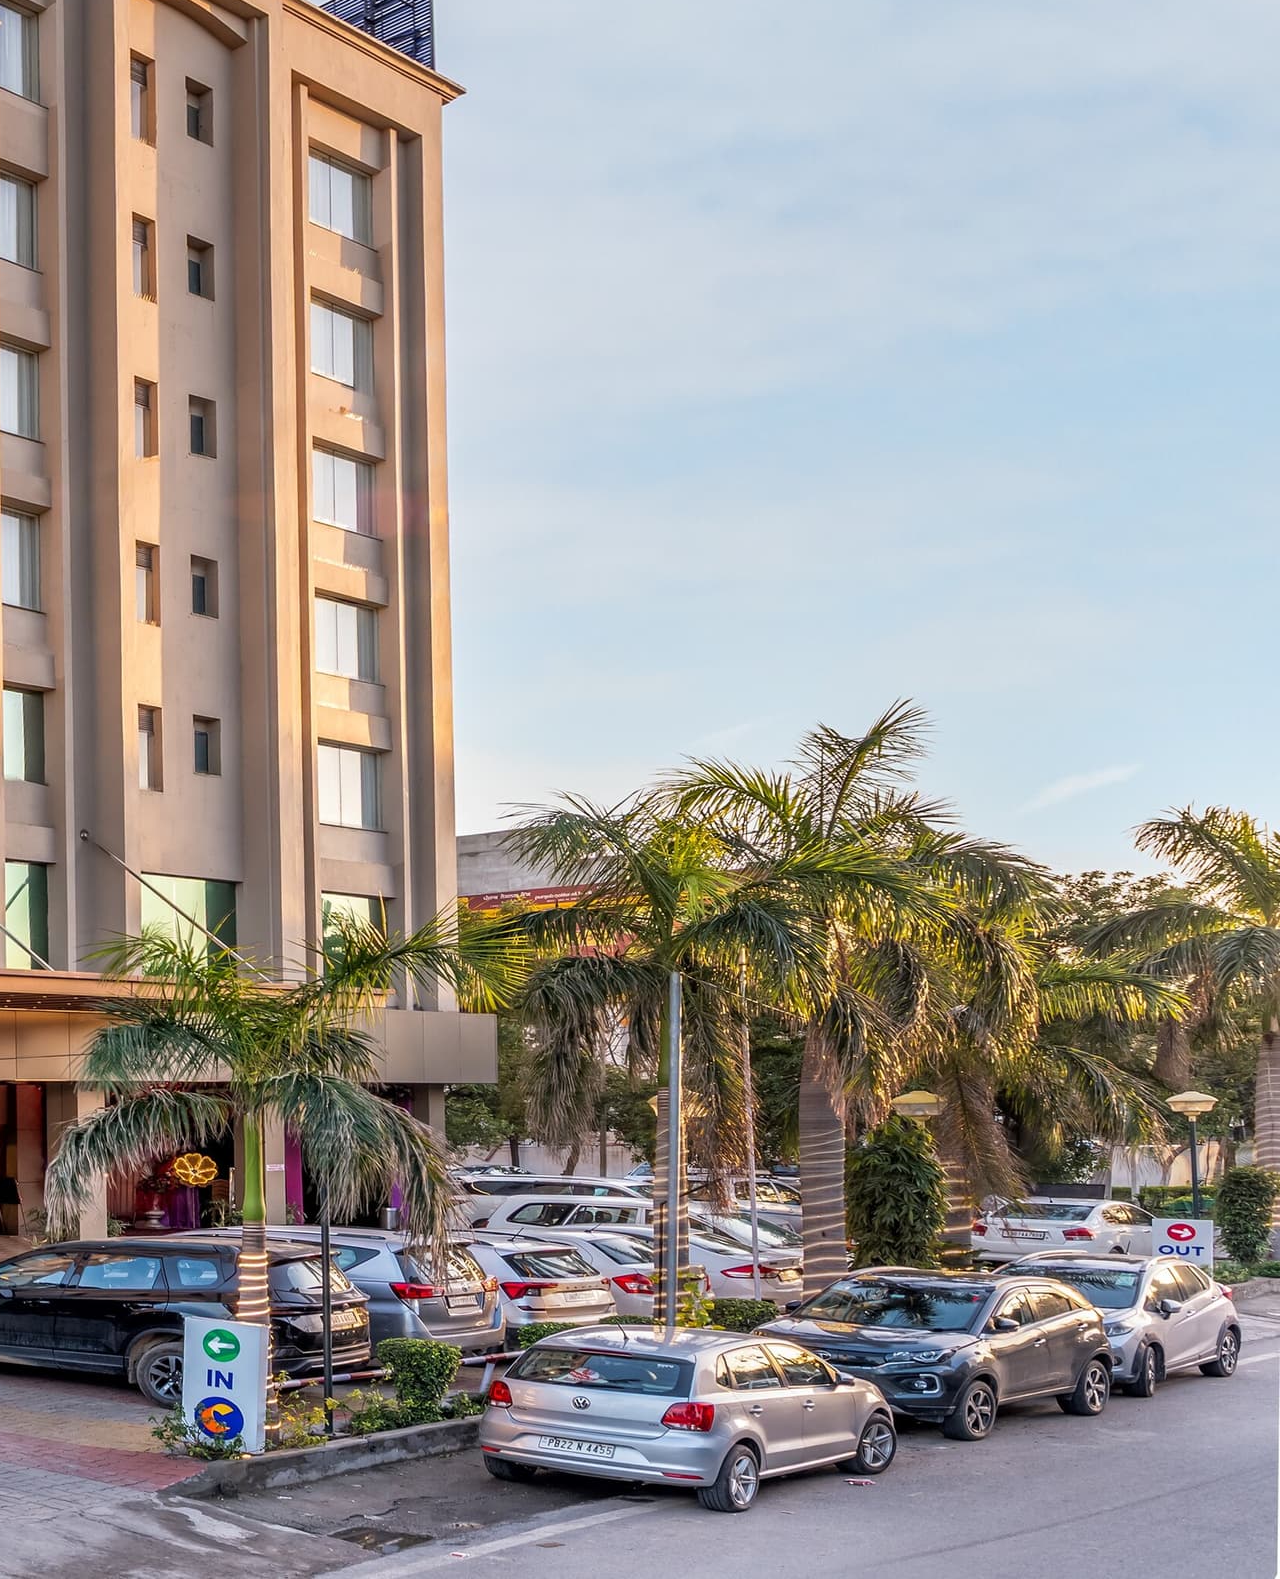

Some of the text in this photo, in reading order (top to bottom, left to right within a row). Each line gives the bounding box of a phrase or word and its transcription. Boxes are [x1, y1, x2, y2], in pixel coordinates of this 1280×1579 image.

[1158, 1245, 1205, 1256] OUT
[207, 1369, 234, 1390] IN
[547, 1438, 613, 1455] PB22 N 4455
